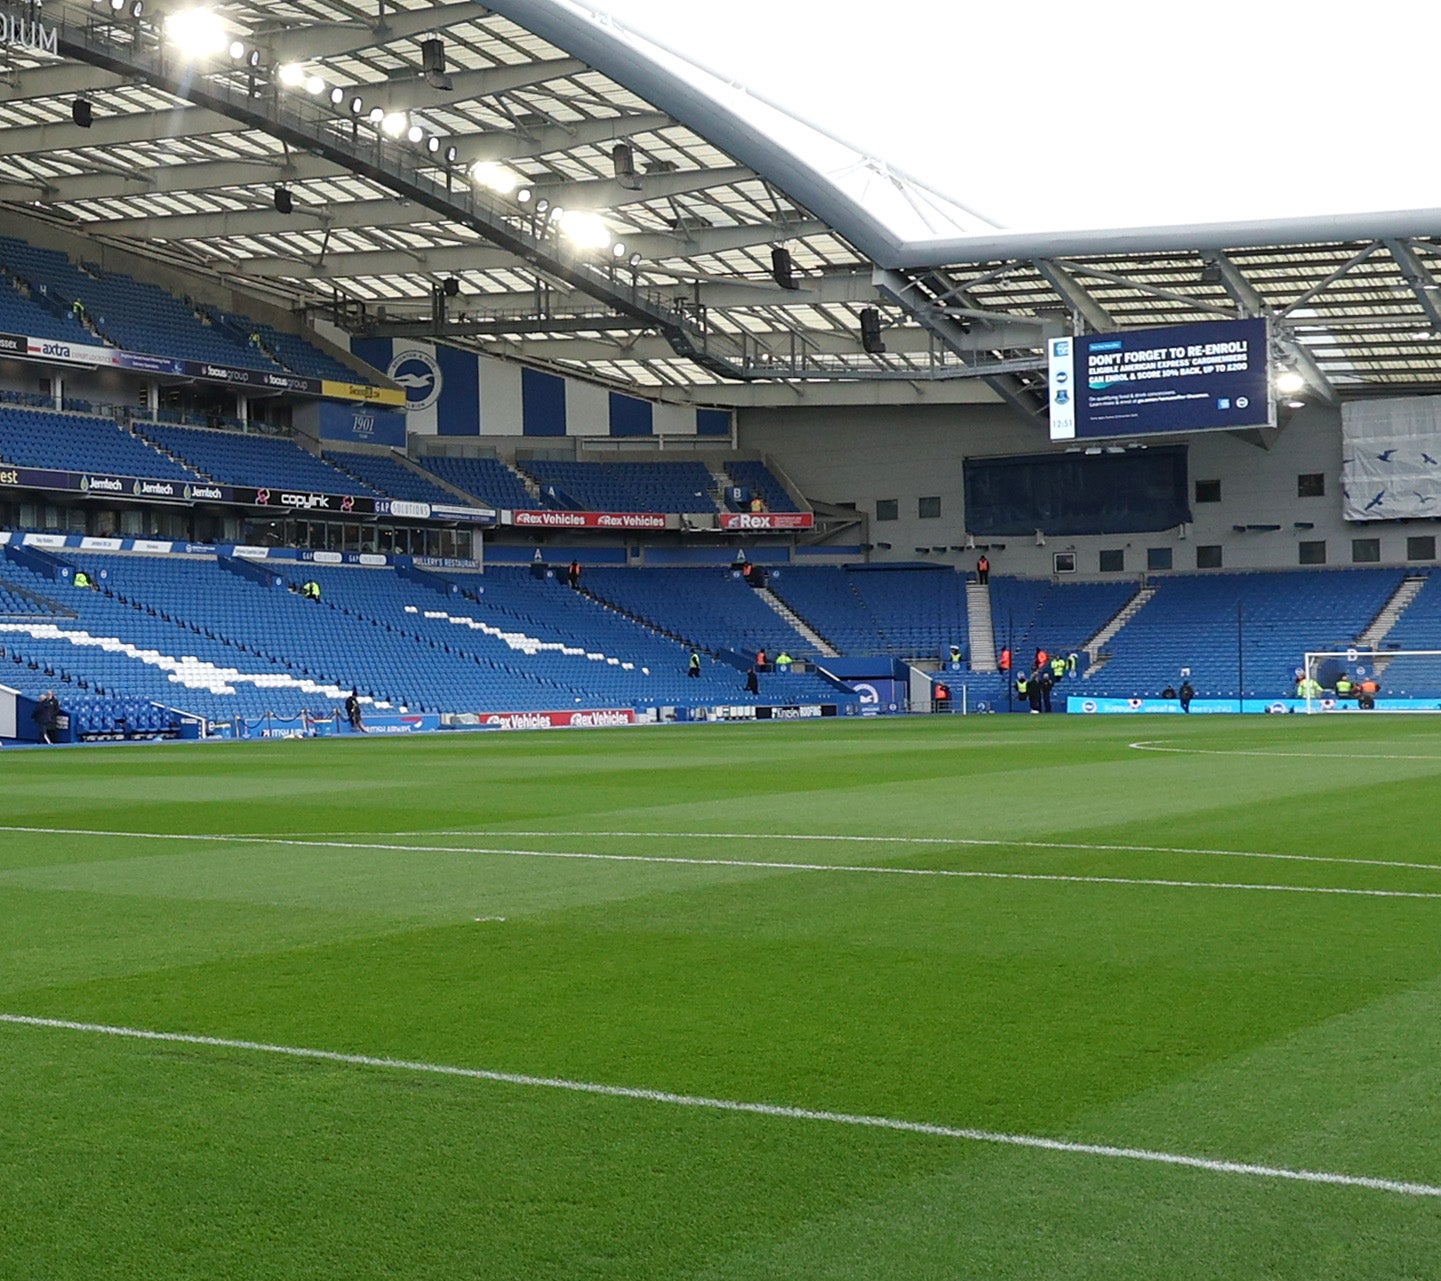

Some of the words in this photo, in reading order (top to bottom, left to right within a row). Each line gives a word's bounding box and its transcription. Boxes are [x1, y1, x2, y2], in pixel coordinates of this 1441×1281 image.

[42, 342, 70, 358] axtra
[1088, 352, 1122, 367] DON'T
[1124, 349, 1167, 363] FORGET
[1169, 347, 1186, 359] TO
[1187, 341, 1248, 357] RE-ENROL!
[548, 486, 555, 497] A
[732, 488, 741, 498] B
[280, 492, 330, 509] copylink
[374, 501, 390, 513] GAP
[391, 502, 429, 516] SOLUTIONS
[524, 513, 543, 525] Rex
[543, 513, 585, 526] Vehicles
[605, 514, 623, 527] Rex
[623, 515, 665, 527] Vehicles
[740, 514, 771, 528] Rex
[534, 548, 543, 559] A
[736, 548, 746, 559] A
[511, 713, 551, 730] Vehicles
[592, 710, 629, 726] Vehicles
